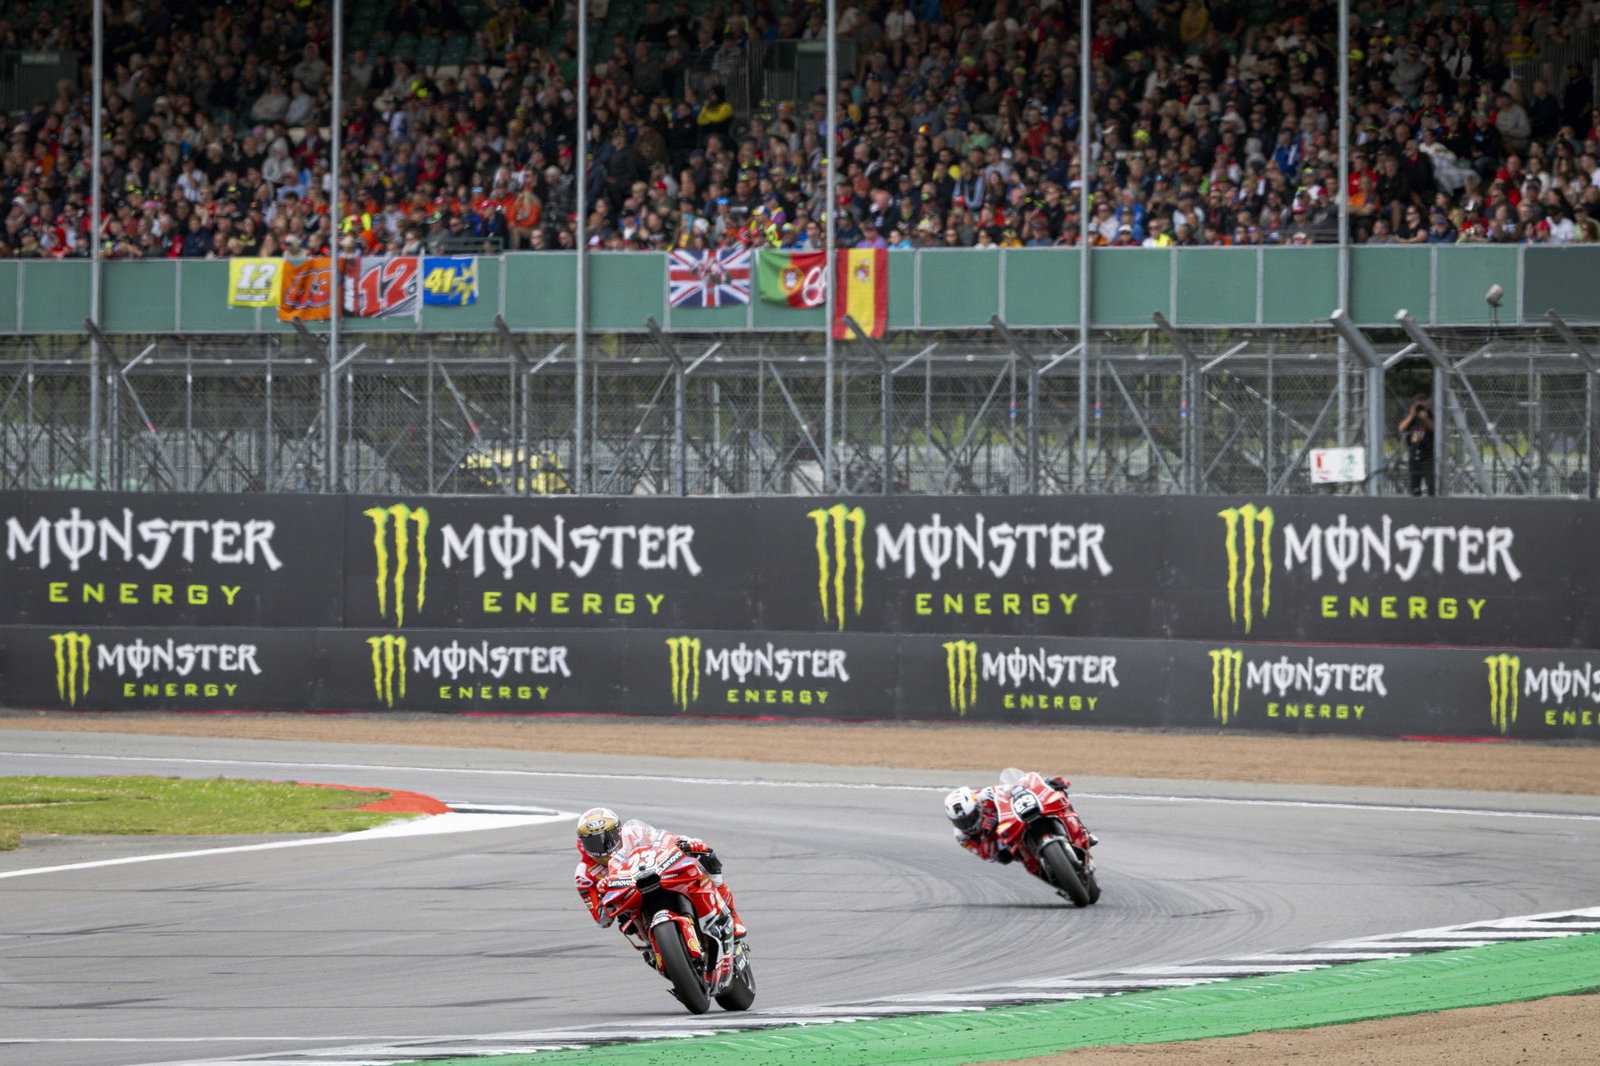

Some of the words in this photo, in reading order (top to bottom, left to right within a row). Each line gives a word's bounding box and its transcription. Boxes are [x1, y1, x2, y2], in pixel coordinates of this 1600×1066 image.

[237, 262, 276, 290] 12
[360, 257, 418, 317] 12
[6, 507, 284, 572] MONSTER
[439, 513, 703, 582] MONSTER
[874, 512, 1114, 582] MONSTER
[1282, 513, 1522, 585] MONSTER
[48, 581, 242, 606] ENERGY
[482, 591, 665, 615] ENERGY
[914, 592, 1078, 615] ENERGY
[1320, 595, 1487, 620] ENERGY
[96, 637, 263, 679] MONSTER
[412, 639, 572, 681] MONSTER
[704, 641, 851, 684] MONSTER
[981, 645, 1120, 689] MONSTER
[123, 682, 237, 697] ENERGY
[1245, 654, 1388, 698] MONSTER
[438, 685, 549, 700] ENERGY
[726, 688, 828, 705] ENERGY
[1003, 693, 1098, 711] ENERGY
[1266, 702, 1365, 720] ENERGY
[1544, 709, 1600, 726] ENE
